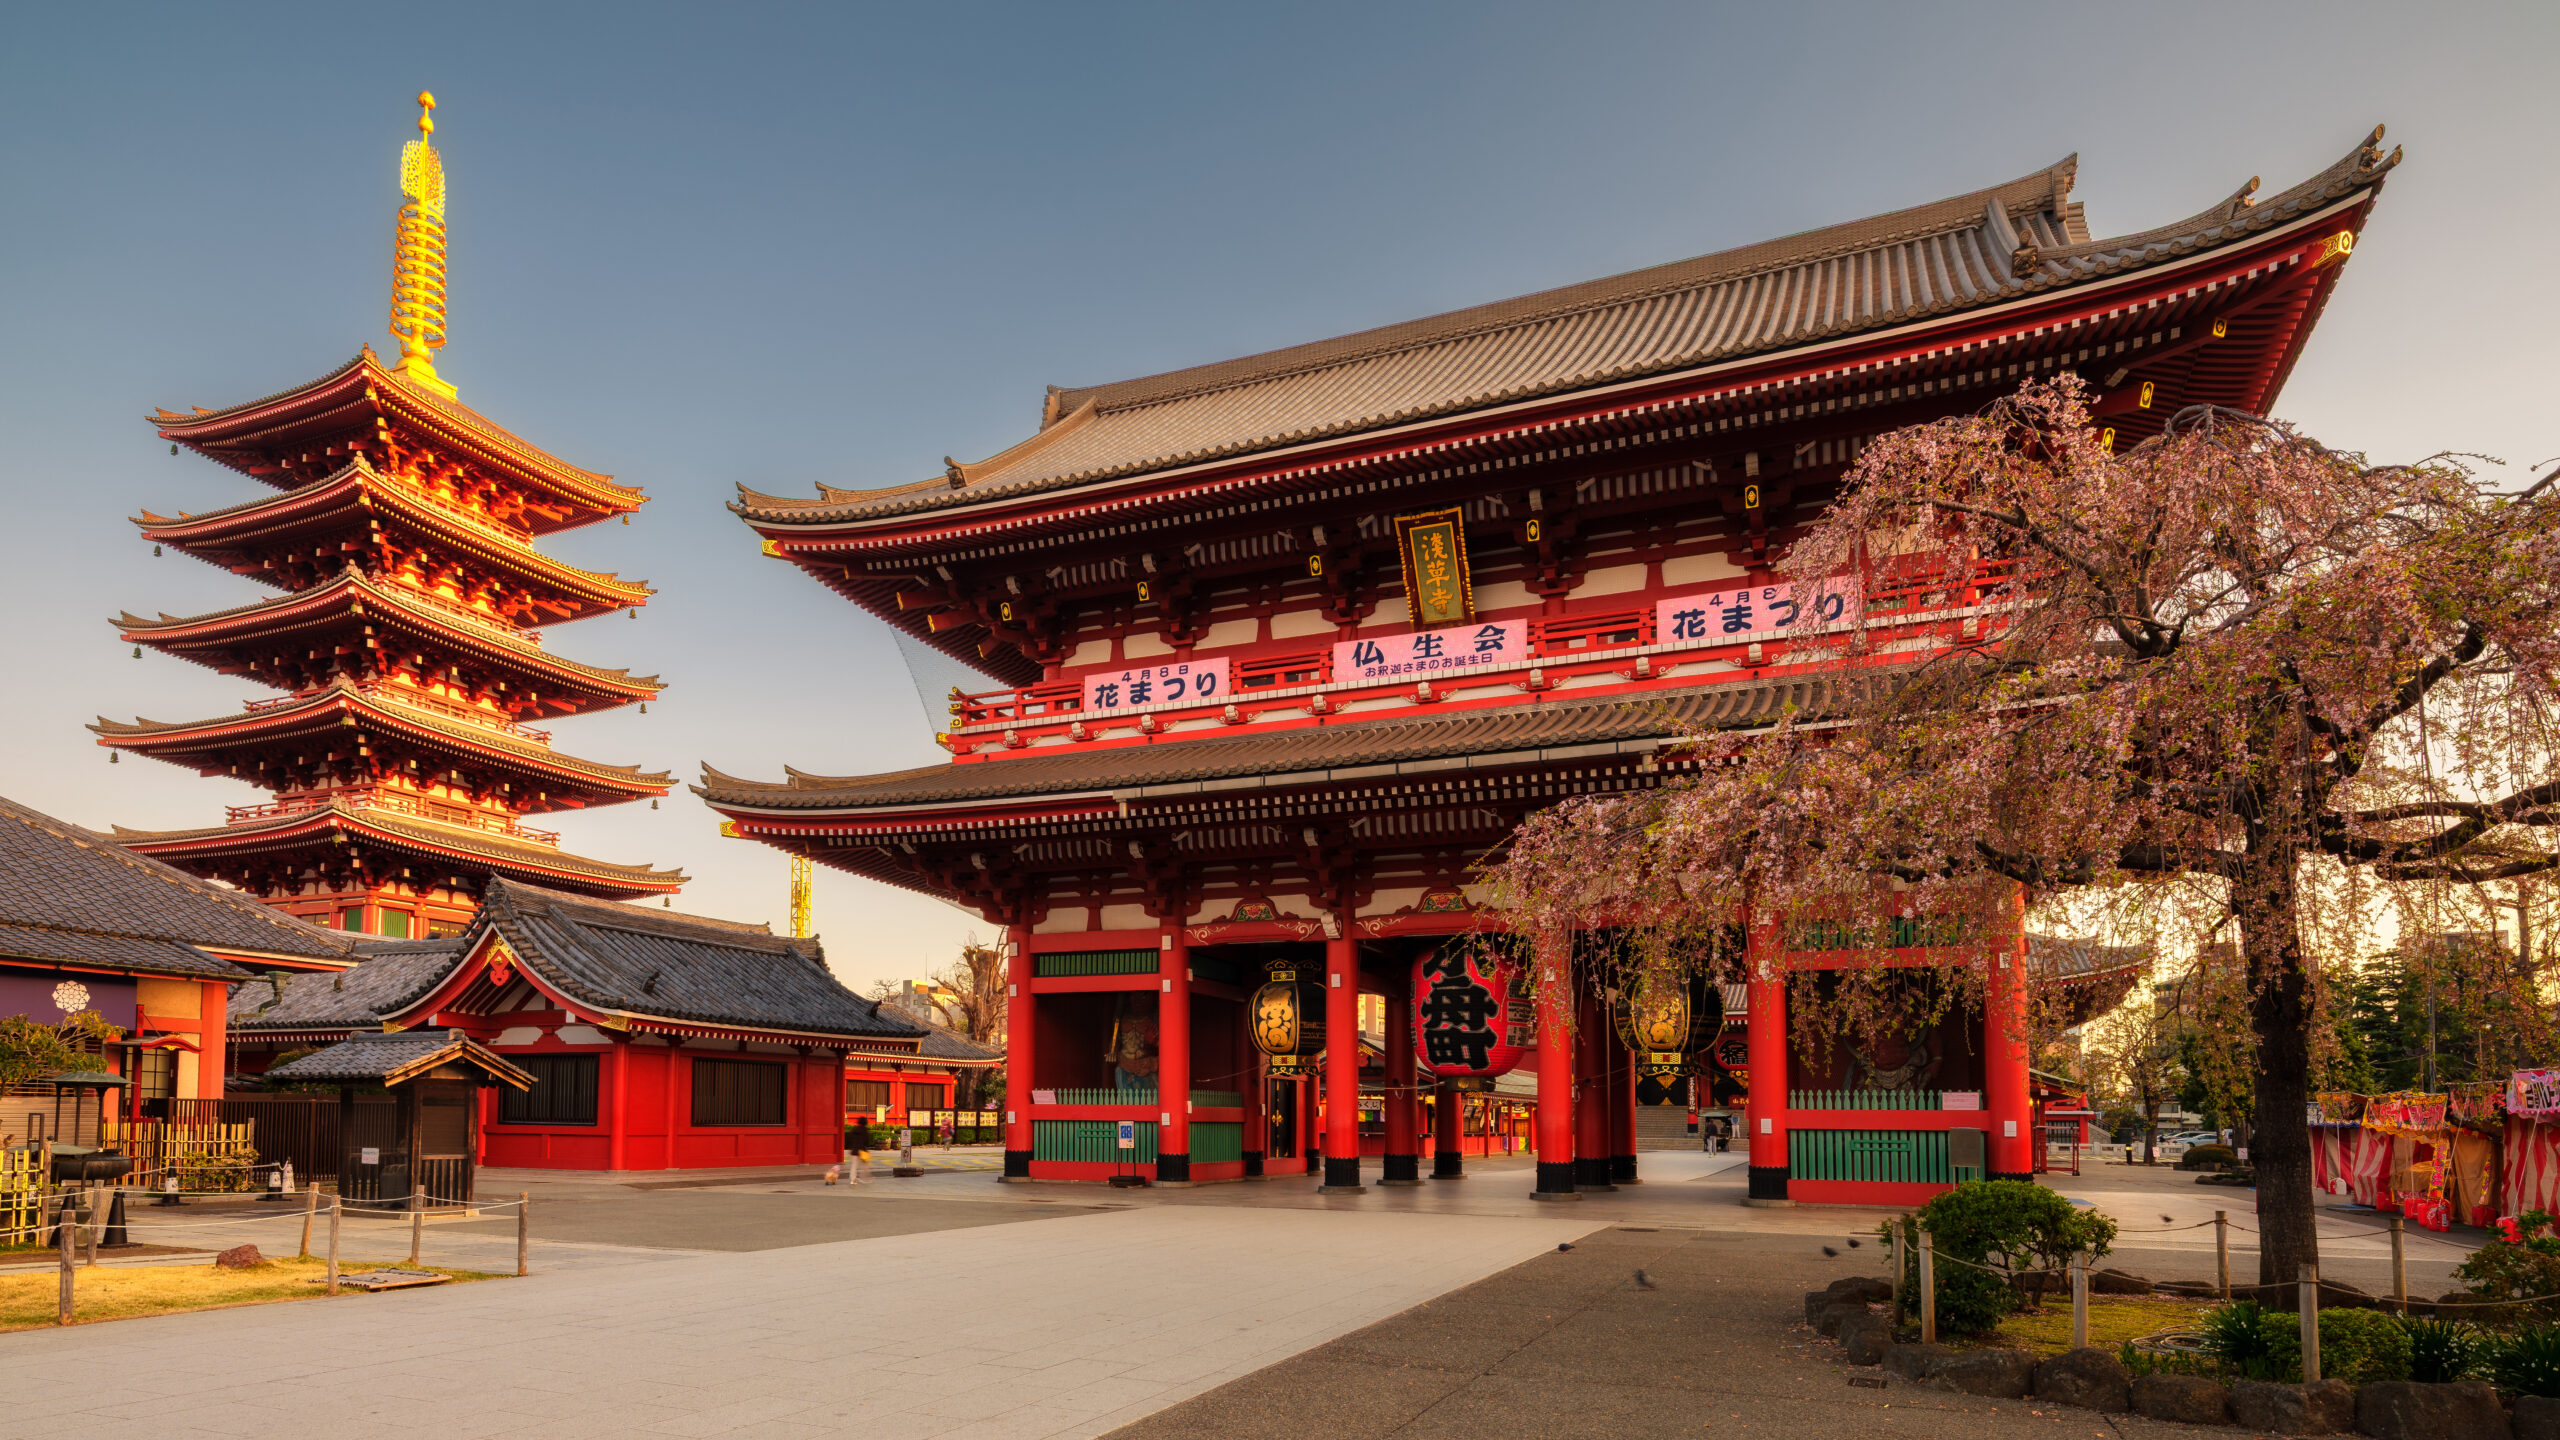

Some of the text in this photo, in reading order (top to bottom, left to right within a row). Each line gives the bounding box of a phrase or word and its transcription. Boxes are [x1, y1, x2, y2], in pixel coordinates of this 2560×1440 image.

[1672, 592, 1844, 640] 花まつり
[1352, 624, 1506, 668] 仏生会
[1121, 664, 1189, 683] 4月8日
[1364, 652, 1493, 678] お釈迦さまのお誕生日
[1094, 672, 1217, 709] 花まつり
